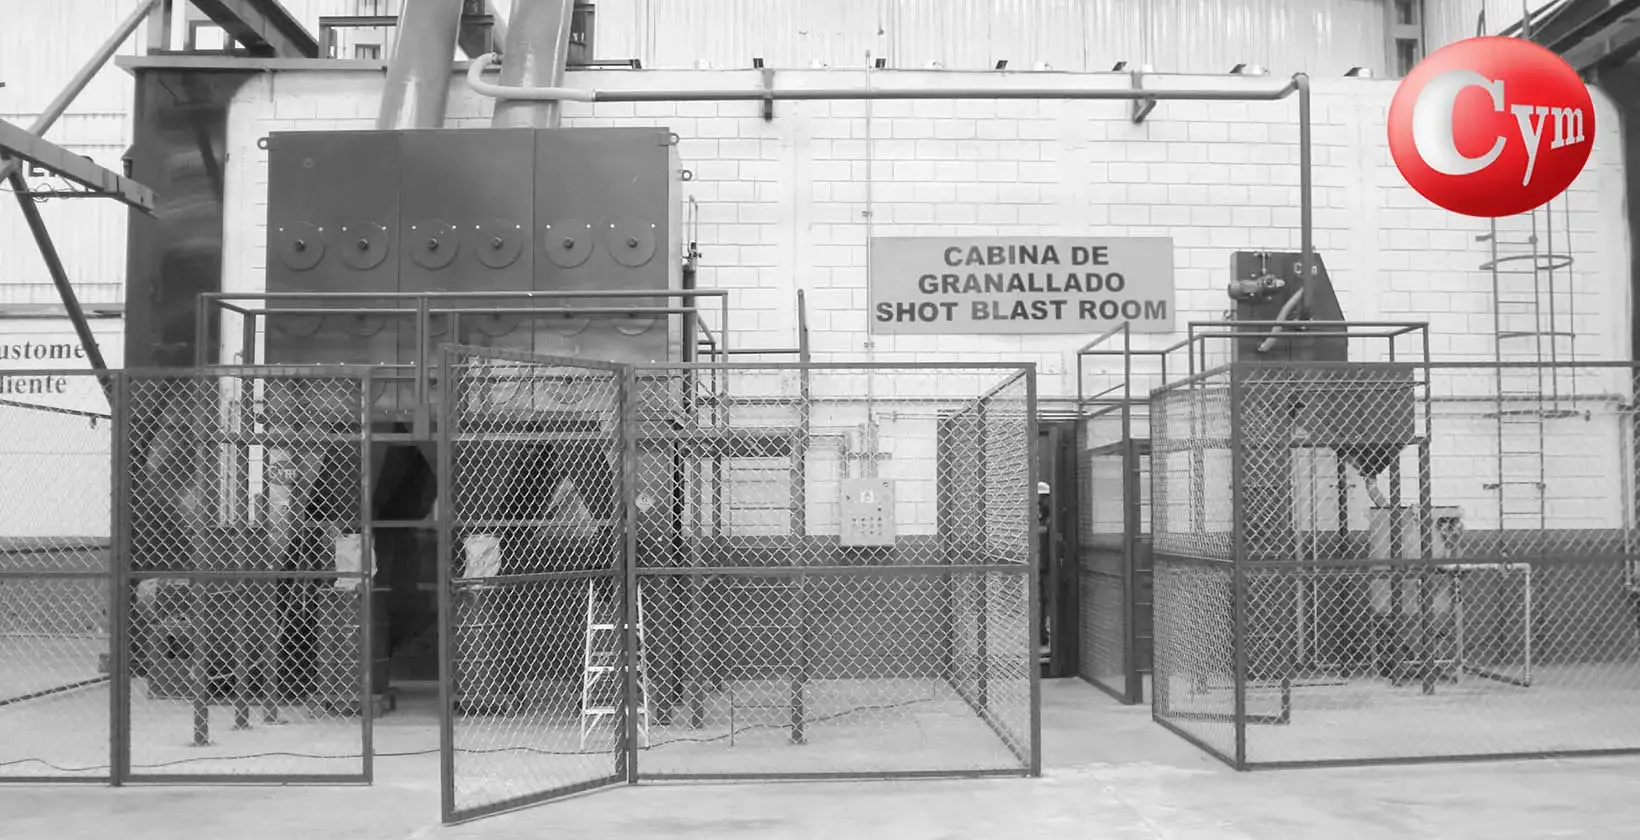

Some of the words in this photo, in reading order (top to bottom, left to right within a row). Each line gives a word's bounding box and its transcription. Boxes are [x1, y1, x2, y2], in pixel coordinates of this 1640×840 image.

[943, 245, 1061, 267] CABINA
[1070, 246, 1109, 266] DE
[918, 272, 1126, 295] GRANALLADO
[875, 301, 959, 323] SHOT
[970, 299, 1068, 321] BLAST
[1078, 299, 1168, 321] ROOM
[0, 340, 99, 360] ustome
